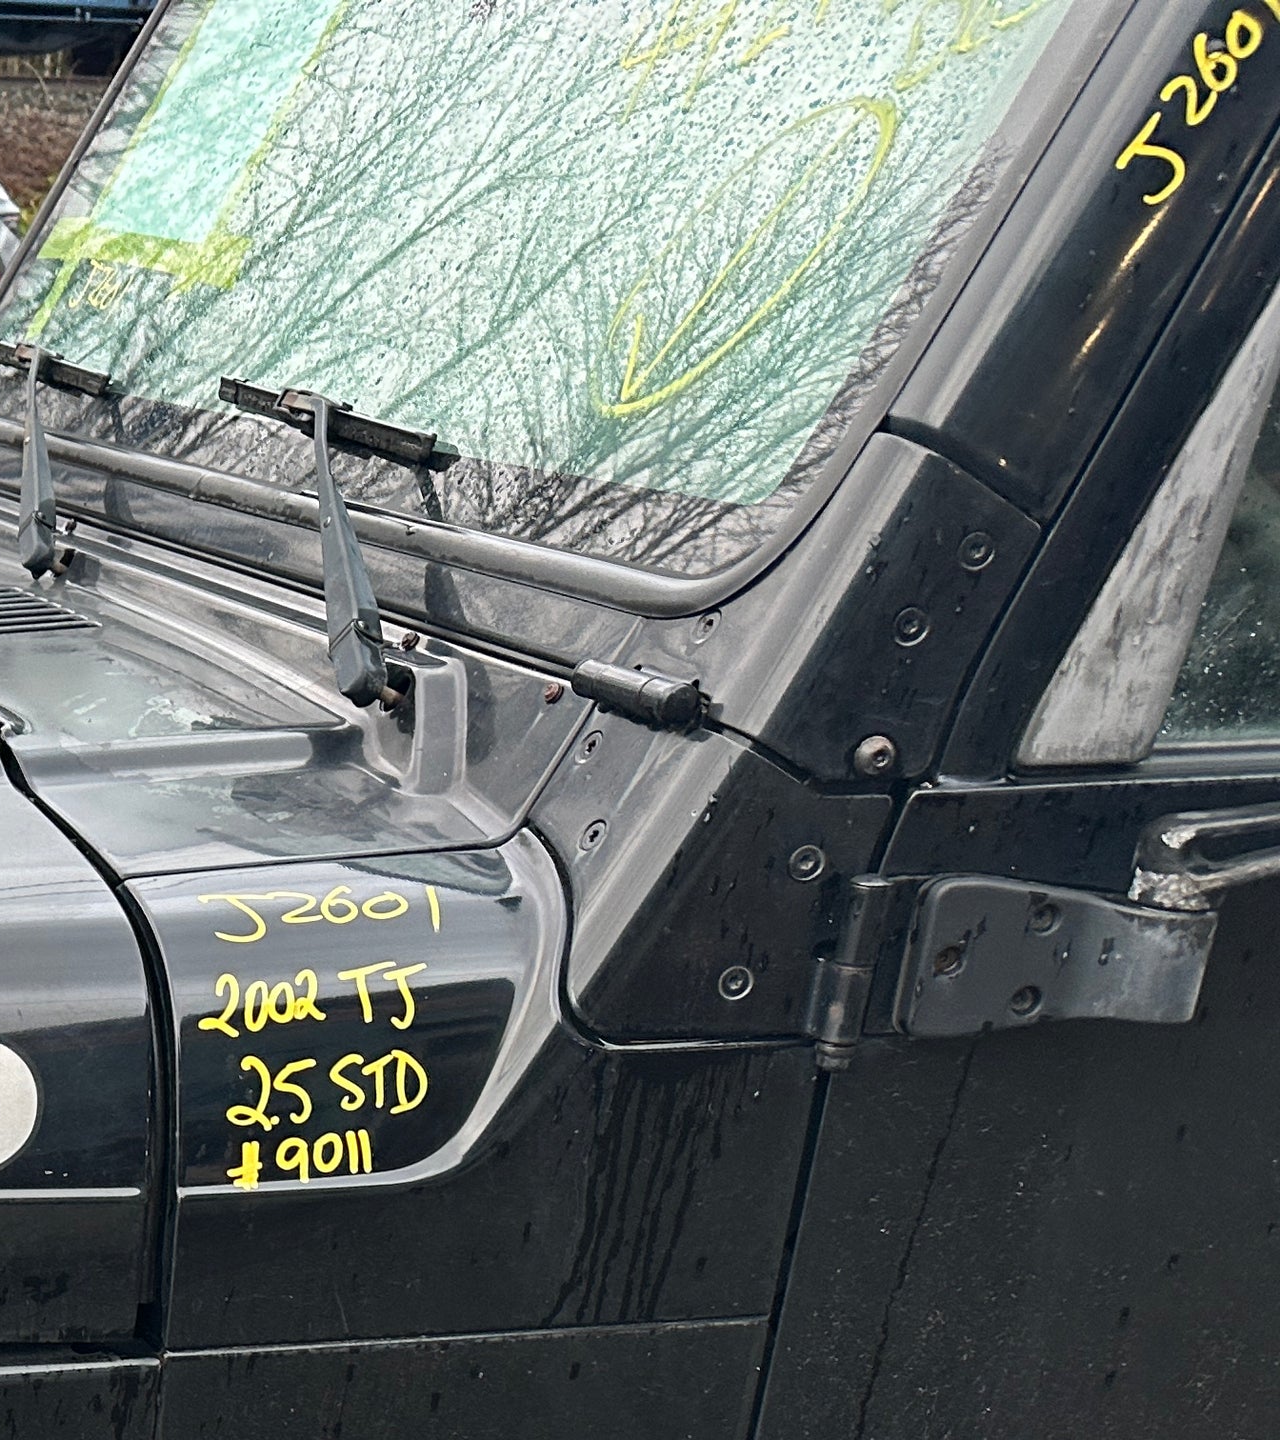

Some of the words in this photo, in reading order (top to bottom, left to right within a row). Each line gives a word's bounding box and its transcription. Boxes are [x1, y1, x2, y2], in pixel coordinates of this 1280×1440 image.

[198, 887, 441, 943] J2601
[198, 969, 327, 1038] 2002
[338, 961, 427, 1030] TJ
[329, 1049, 428, 1114] STD
